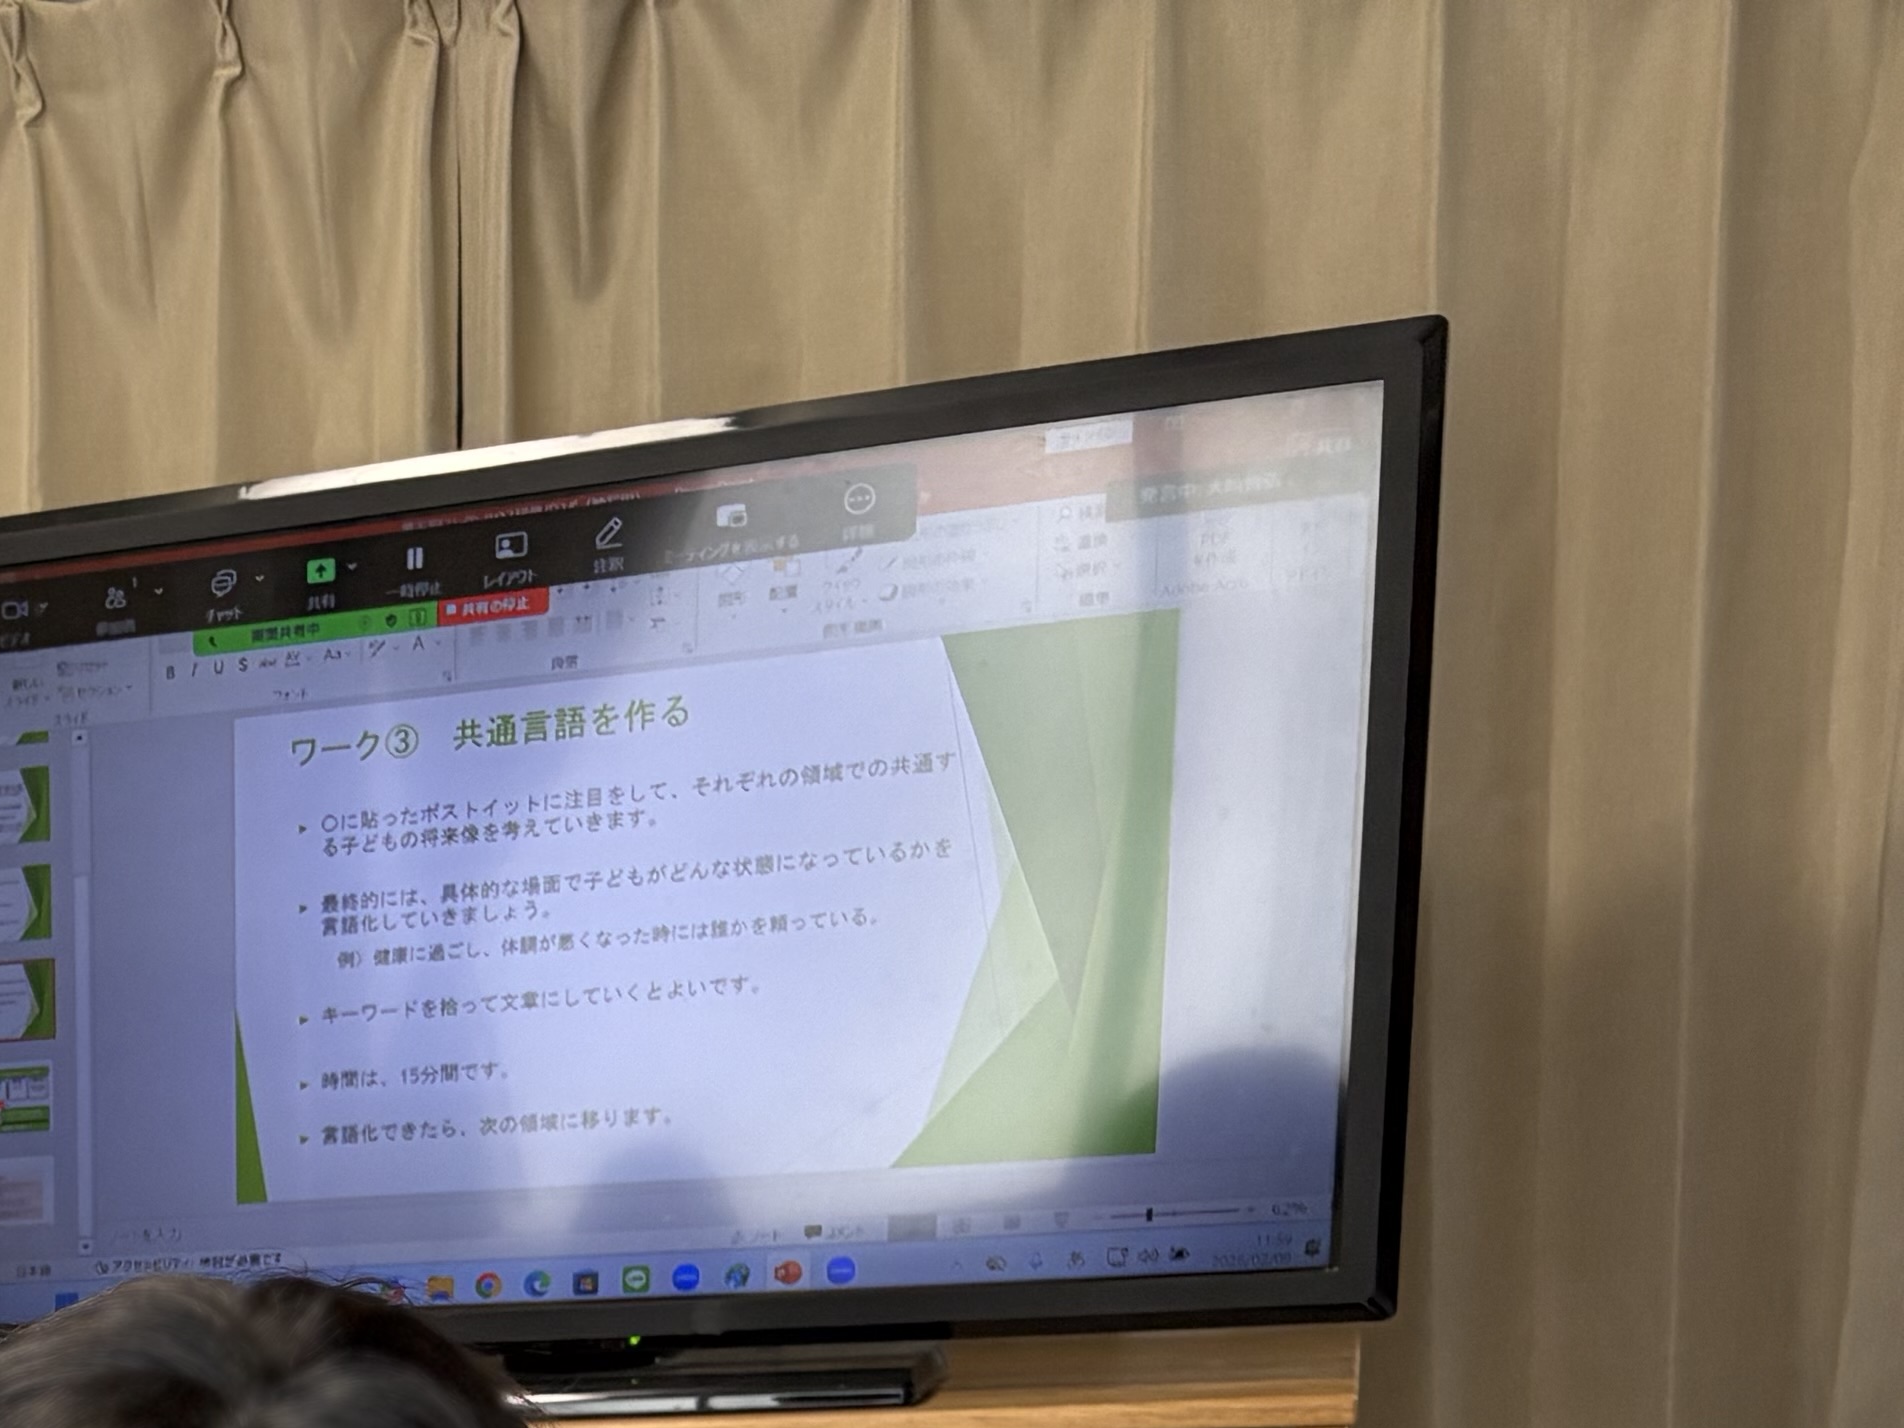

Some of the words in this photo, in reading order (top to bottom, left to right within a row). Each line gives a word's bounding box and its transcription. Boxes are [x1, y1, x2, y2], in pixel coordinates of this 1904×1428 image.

[290, 722, 420, 768] ワーク③
[452, 694, 690, 751] 共通言語を作る
